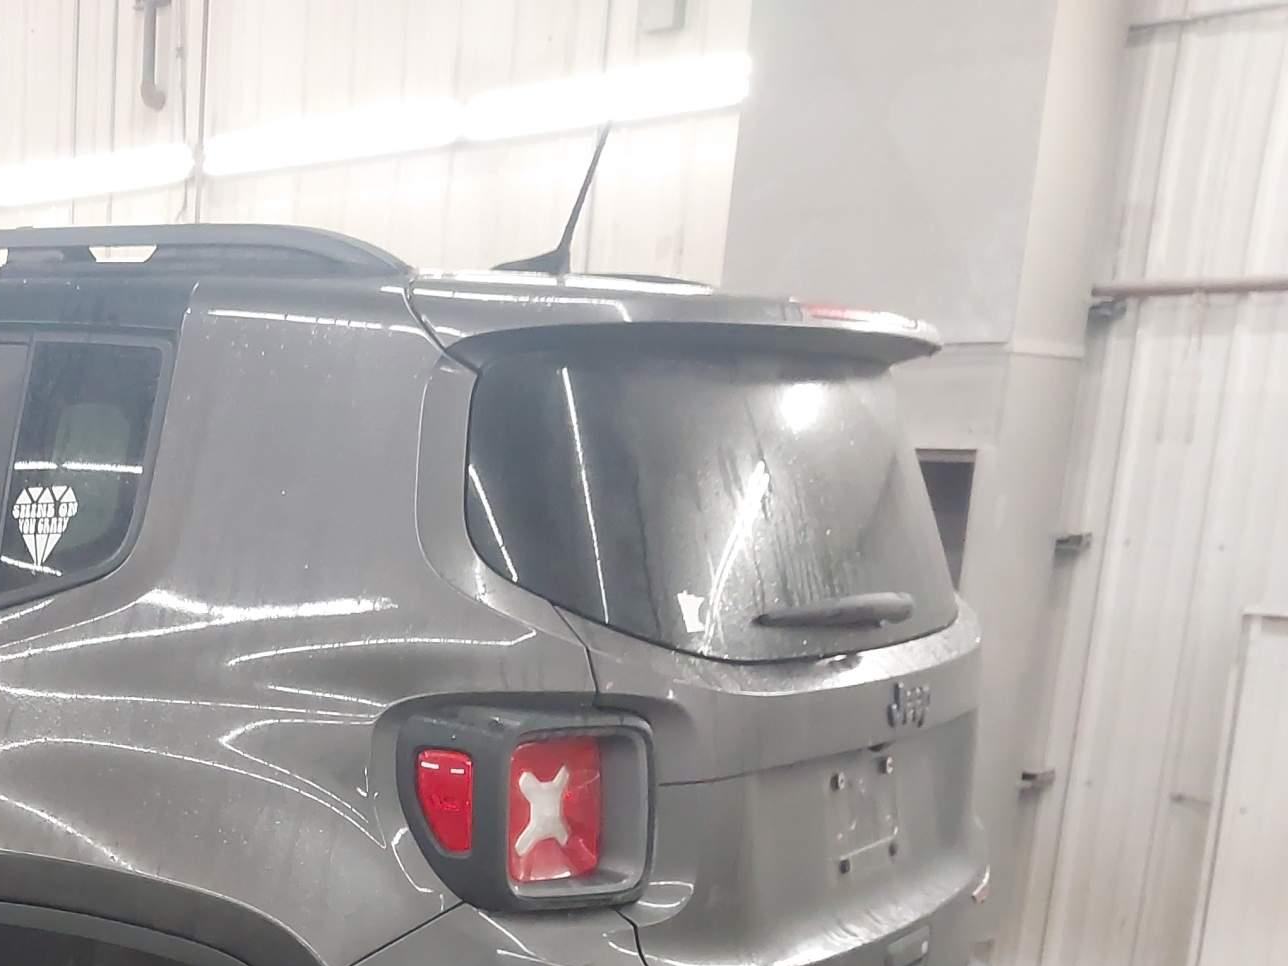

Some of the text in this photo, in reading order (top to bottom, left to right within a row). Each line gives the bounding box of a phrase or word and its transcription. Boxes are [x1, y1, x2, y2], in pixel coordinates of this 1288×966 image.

[12, 501, 79, 519] SHINE ON
[18, 516, 37, 534] YOU
